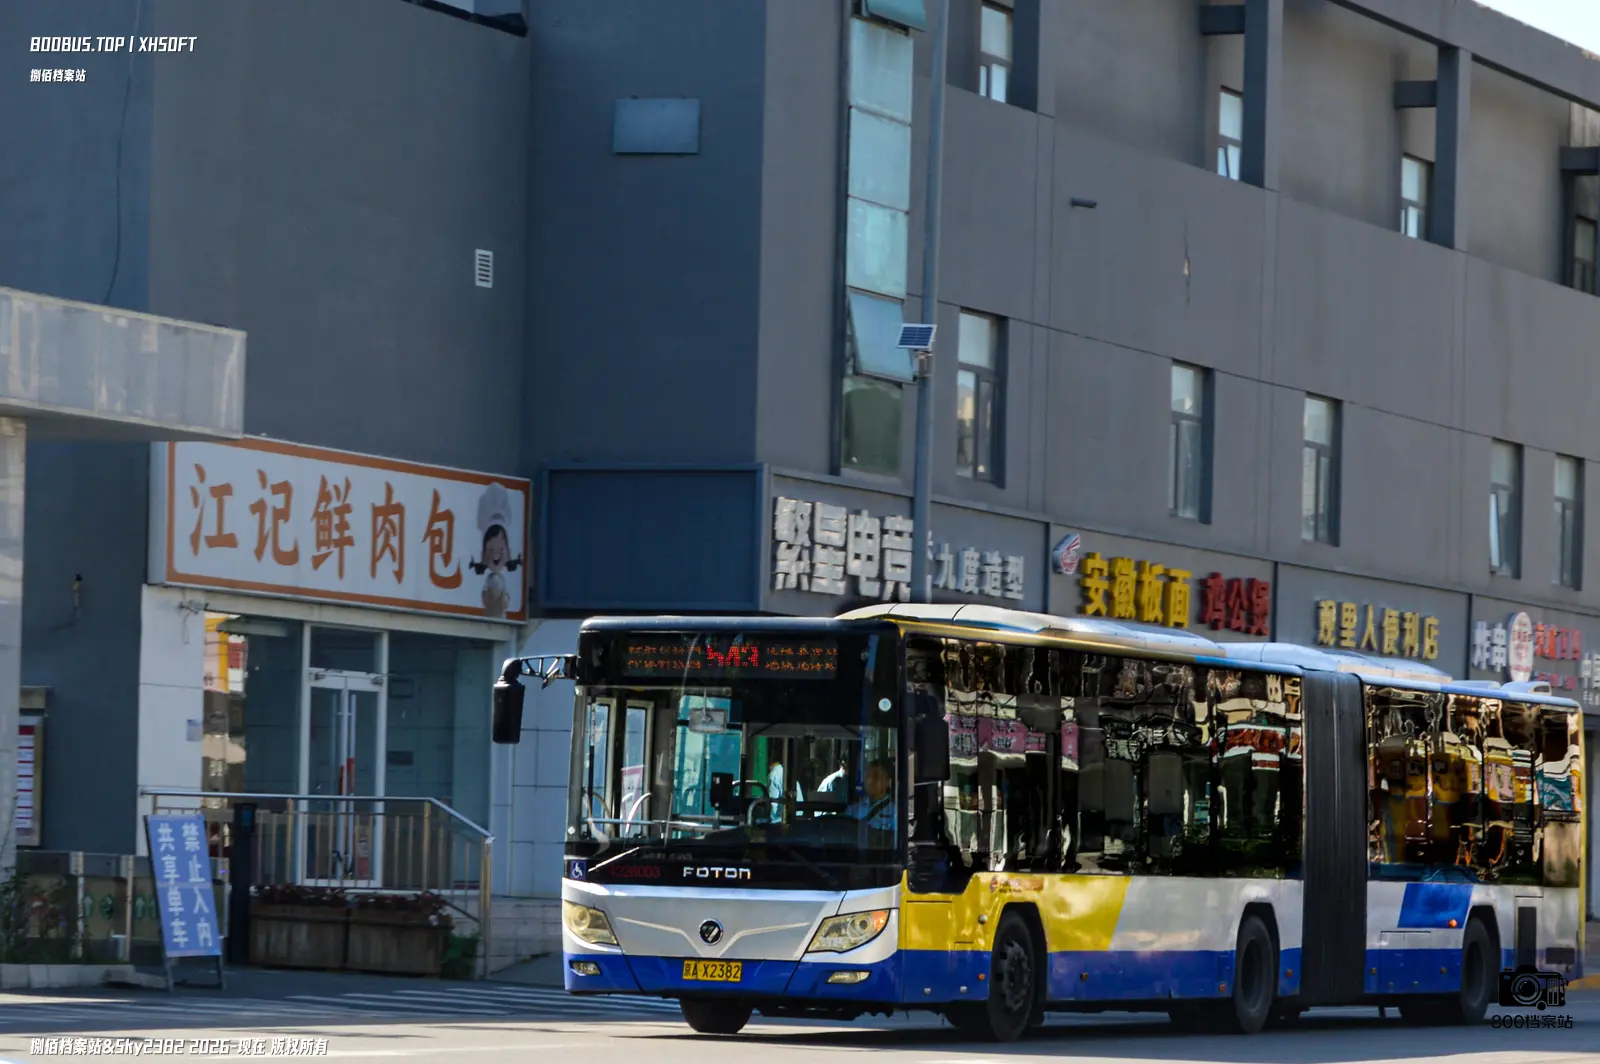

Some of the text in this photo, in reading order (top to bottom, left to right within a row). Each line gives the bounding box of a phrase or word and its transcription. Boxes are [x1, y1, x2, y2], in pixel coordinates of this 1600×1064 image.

[188, 463, 464, 590] 江记鲜肉包
[1080, 551, 1193, 630] 安徽板面
[156, 822, 190, 948] 共享单车
[181, 822, 214, 948] 禁止入内
[682, 866, 751, 881] FOTON
